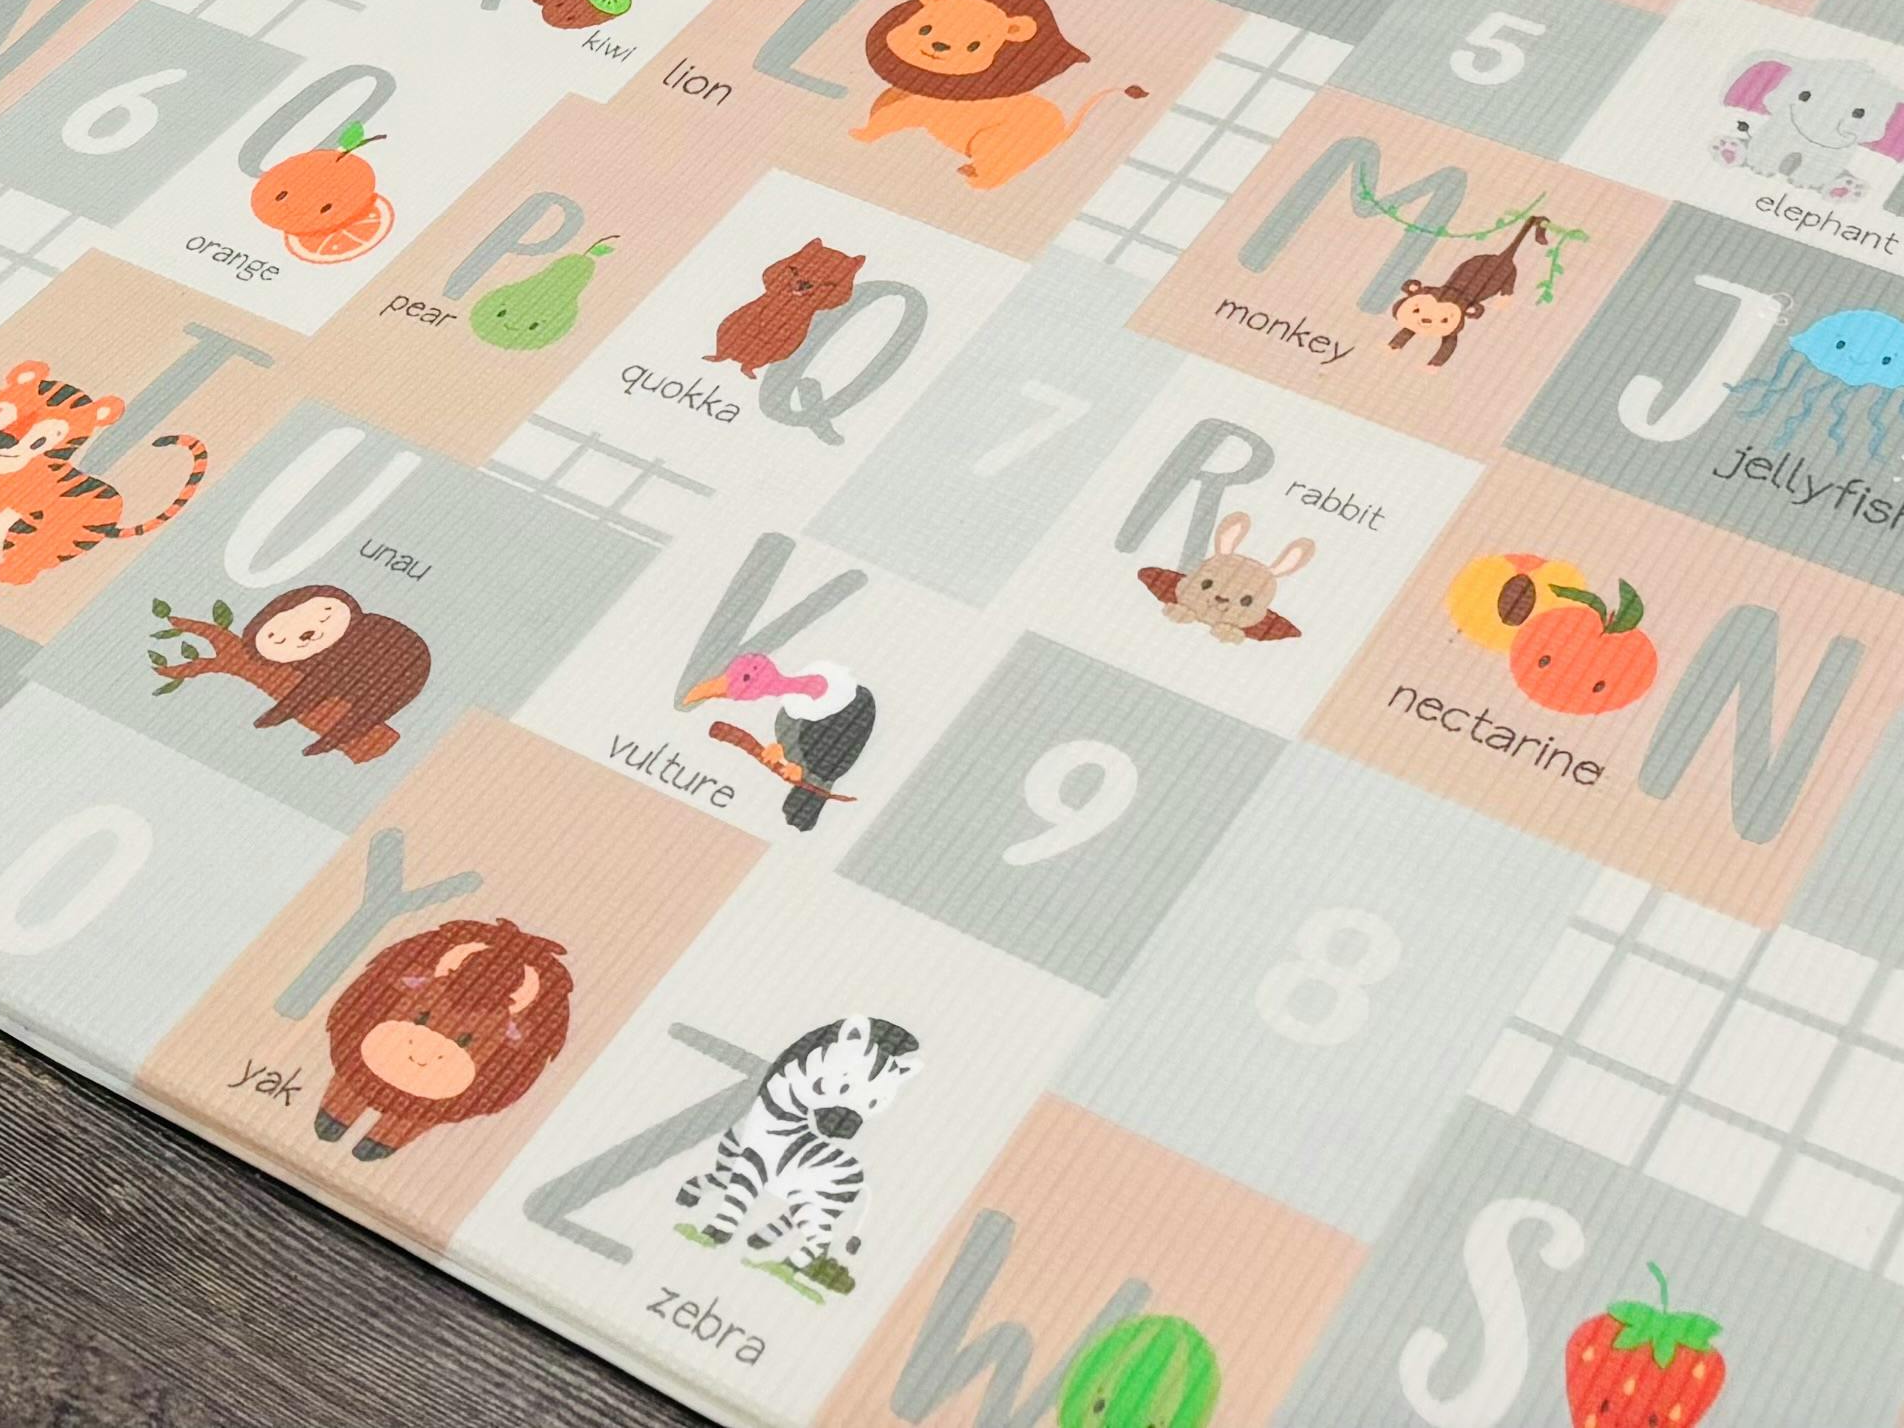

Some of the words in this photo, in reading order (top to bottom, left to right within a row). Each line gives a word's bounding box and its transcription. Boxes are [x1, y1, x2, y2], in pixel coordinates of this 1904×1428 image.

[660, 54, 735, 111] lion
[1448, 10, 1550, 87] 5
[59, 67, 189, 157] 6
[183, 228, 284, 287] orange
[441, 189, 585, 303] P
[1235, 135, 1469, 316] M
[1752, 188, 1904, 258] elephant
[377, 289, 461, 332] pear
[757, 277, 930, 448] Q
[1213, 291, 1357, 368] monkey
[1616, 273, 1782, 444] J
[77, 320, 276, 478] T
[619, 359, 743, 427] quokka
[971, 378, 1097, 480] 7
[221, 425, 423, 590] U
[1113, 416, 1276, 568] R
[1283, 472, 1390, 535] rabbit
[358, 532, 435, 584] unau
[673, 530, 871, 712] V
[607, 729, 738, 812] vulture
[1387, 681, 1606, 787] nectarine
[1637, 603, 1867, 845] N
[1001, 738, 1140, 867] 9
[272, 826, 484, 1021] Y
[1254, 904, 1403, 1048] 8
[224, 1057, 306, 1111] yak
[521, 1021, 773, 1266] Z
[644, 1284, 769, 1369] zebra
[1396, 1196, 1586, 1428] S
